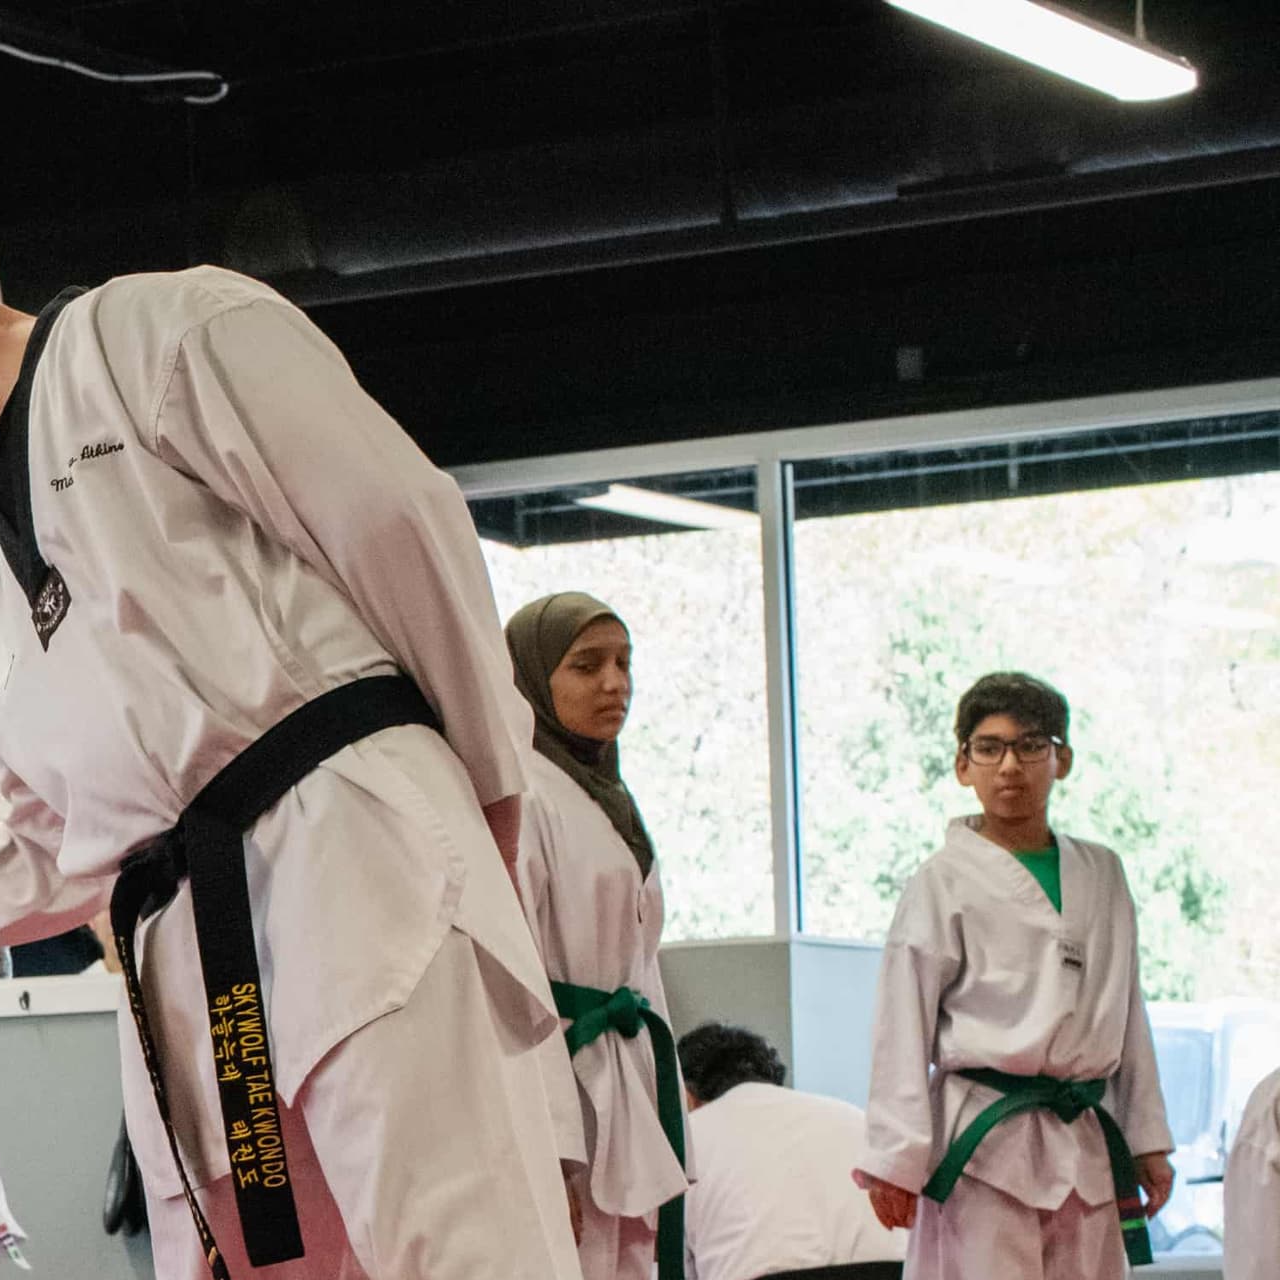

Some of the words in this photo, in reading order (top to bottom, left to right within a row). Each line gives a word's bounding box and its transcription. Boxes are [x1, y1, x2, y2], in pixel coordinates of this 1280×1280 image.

[232, 983, 267, 1066] SKYWOLF
[210, 994, 242, 1081] 하늘늑대
[229, 1120, 259, 1189] 태권도
[245, 1070, 273, 1105] TAE
